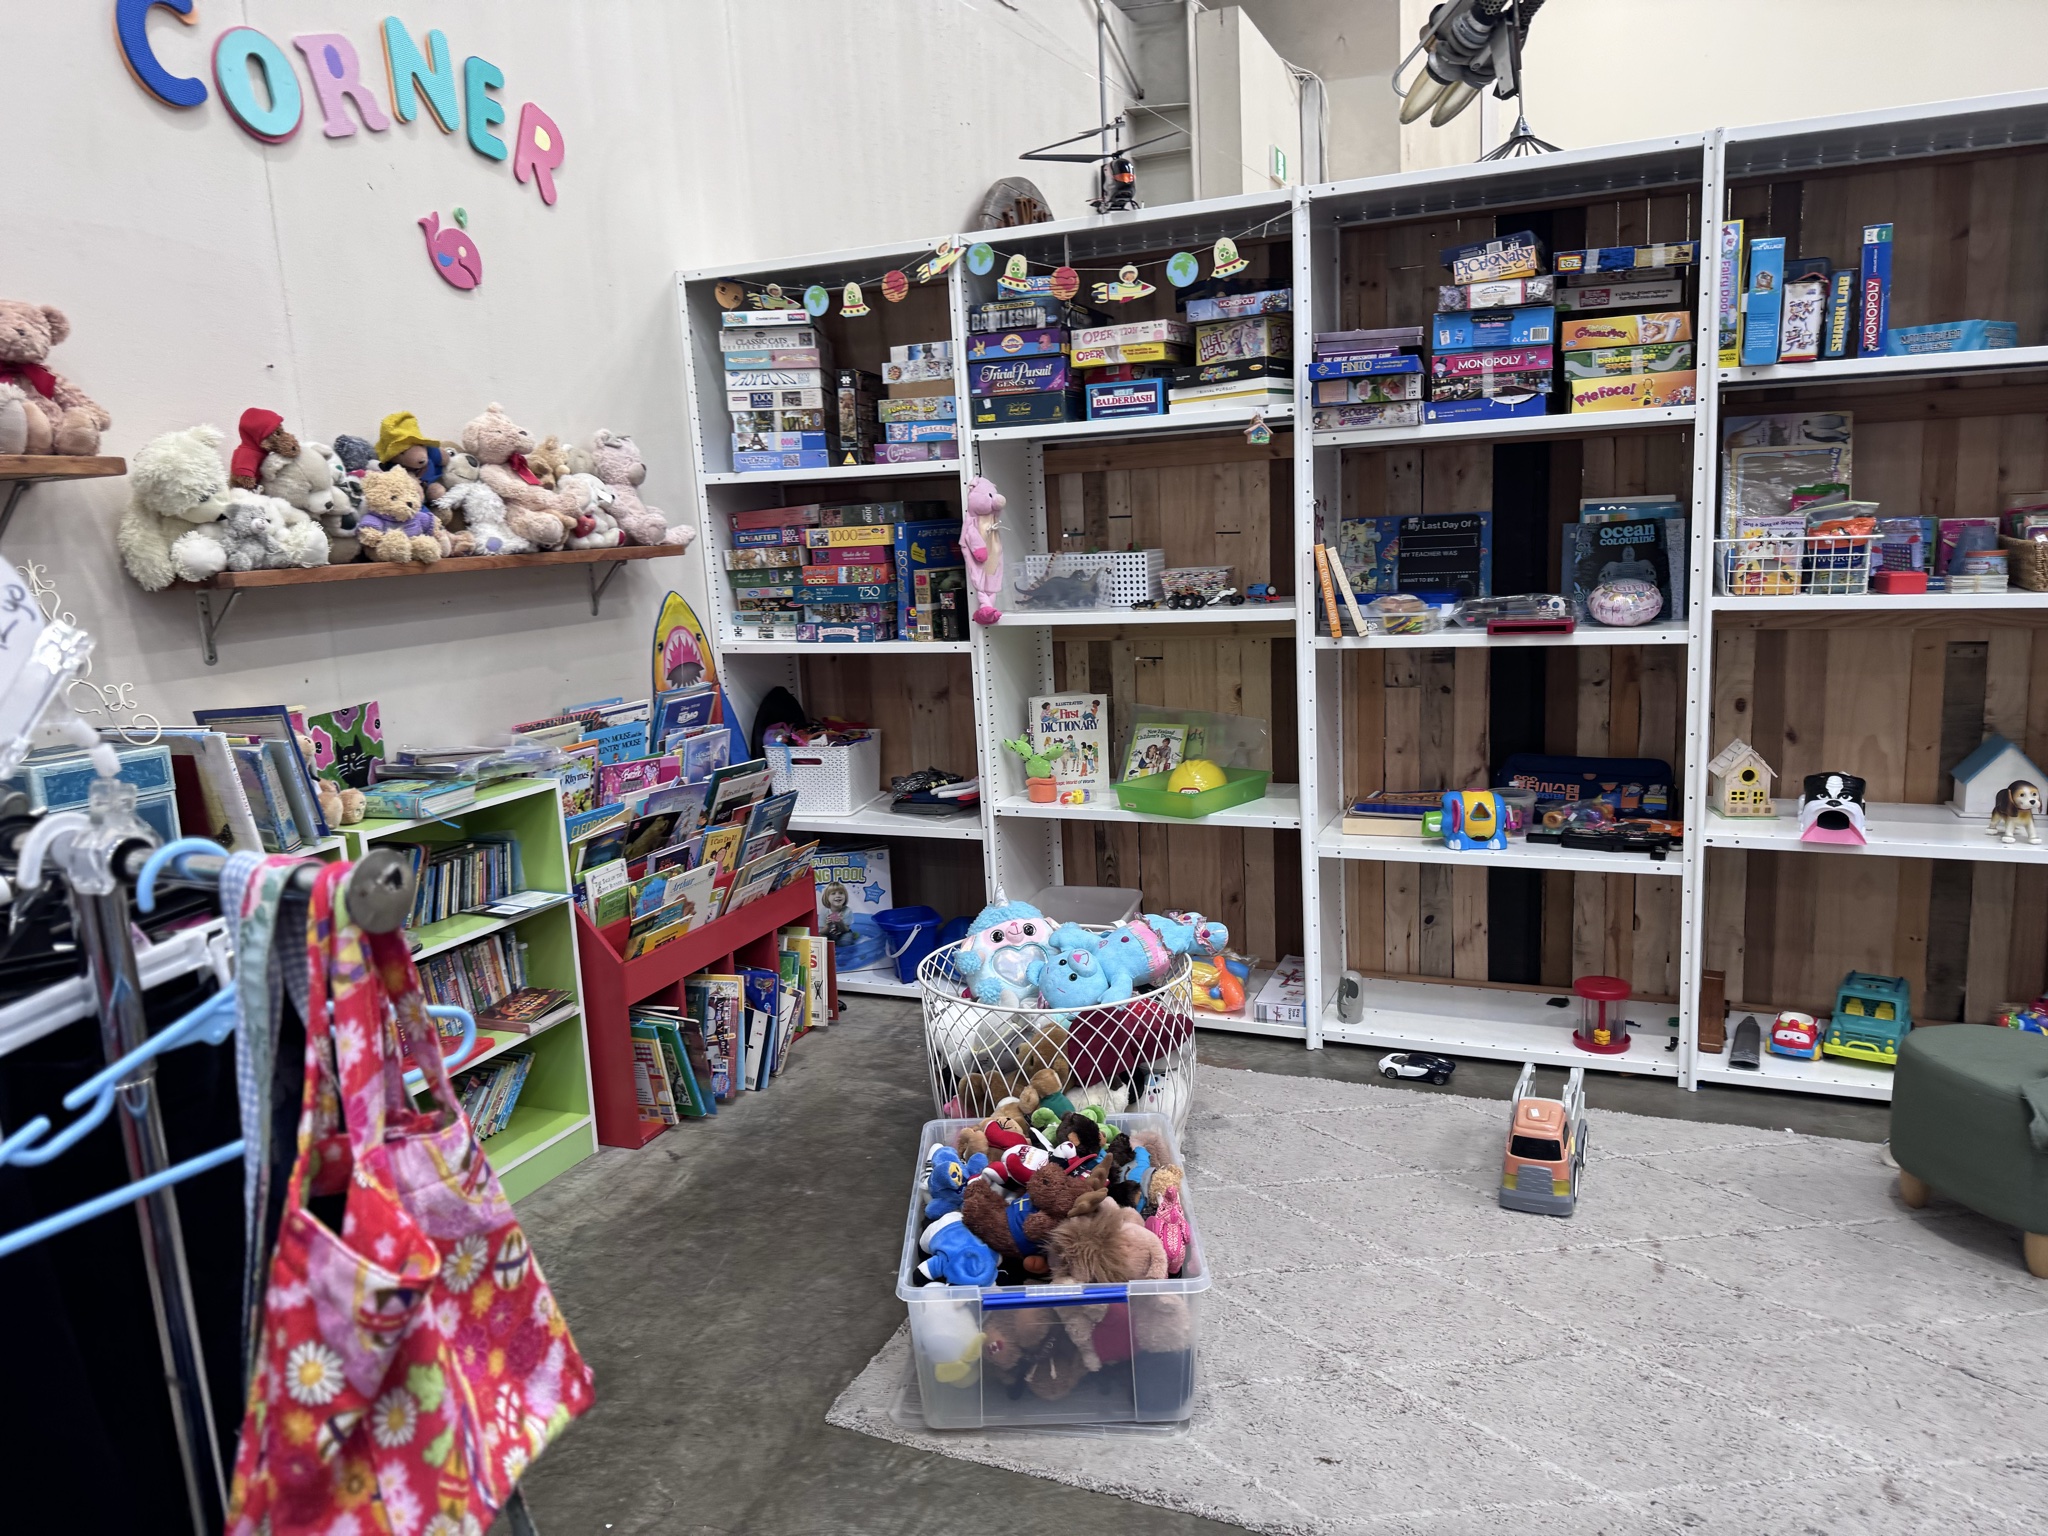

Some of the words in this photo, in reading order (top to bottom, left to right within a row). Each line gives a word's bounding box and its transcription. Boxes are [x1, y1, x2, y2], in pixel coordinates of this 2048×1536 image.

[113, 0, 565, 205] CORNER
[1836, 276, 1851, 303] LAB
[1220, 298, 1255, 308] MONOPOLY
[1720, 290, 1731, 315] Door
[971, 307, 1046, 331] BATTLESHIP
[1866, 280, 1880, 345] MONOPOLY
[1831, 306, 1847, 352] SHARK
[1201, 331, 1223, 348] WET
[1200, 341, 1228, 361] HEAD
[1458, 355, 1521, 369] MONOPOLY
[981, 365, 1016, 383] Trivial
[1013, 362, 1053, 384] Pursuit
[1096, 394, 1153, 406] BALDERDASH
[1408, 523, 1420, 531] My
[1422, 521, 1441, 530] Last
[1442, 521, 1459, 530] Day
[1460, 520, 1472, 528] Of
[1600, 524, 1655, 538] ocean
[830, 529, 858, 542] 1000
[1600, 535, 1655, 546] COLOURING
[858, 586, 880, 597] 750
[1060, 709, 1079, 719] First
[1041, 719, 1099, 733] DICTIONARY
[612, 732, 631, 743] MOUSE
[621, 739, 641, 750] MOUSE
[565, 772, 590, 784] Rhymes
[713, 837, 724, 845] Can
[724, 836, 731, 844] Do
[833, 868, 866, 881] POOL
[672, 877, 695, 892] Arthur
